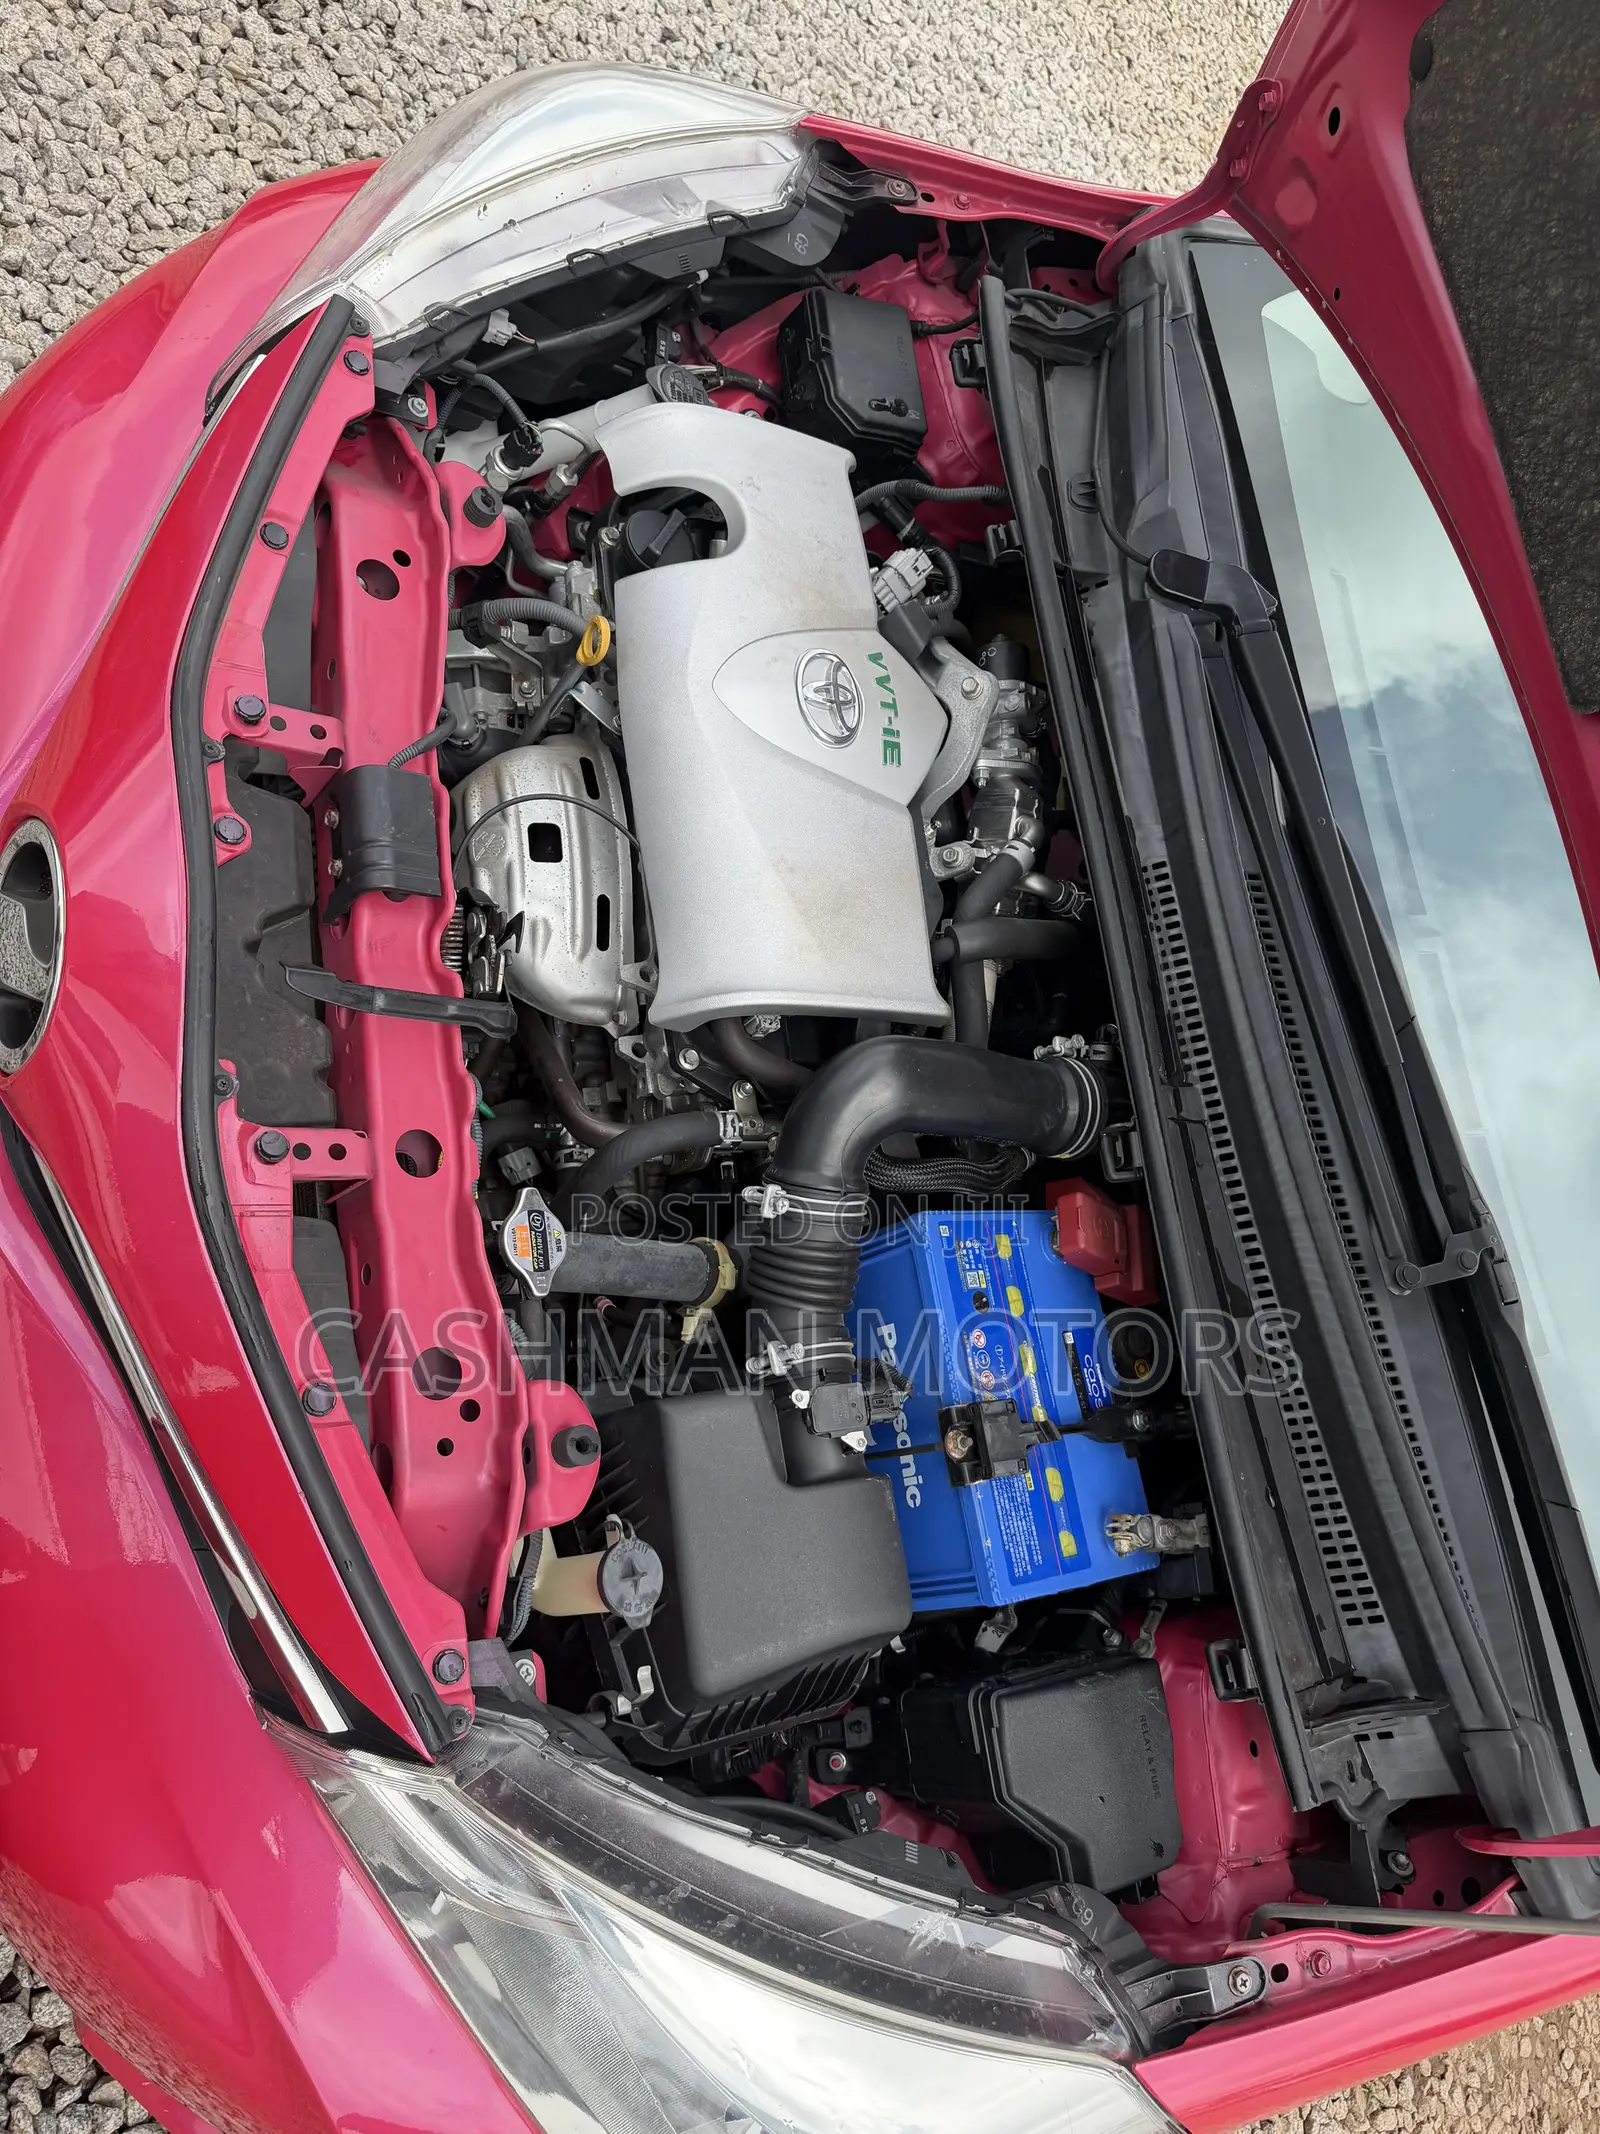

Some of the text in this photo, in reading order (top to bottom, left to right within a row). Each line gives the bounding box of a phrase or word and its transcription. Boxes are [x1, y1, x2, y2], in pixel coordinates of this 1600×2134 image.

[866, 651, 901, 767] VVT-iE
[536, 1232, 545, 1270] DRIVE JOY
[1084, 1354, 1103, 1409] caos
[878, 1323, 924, 1509] Pasonic
[1139, 1714, 1154, 1753] RELAY
[1147, 1756, 1155, 1765] &
[1149, 1768, 1162, 1800] FUSE
